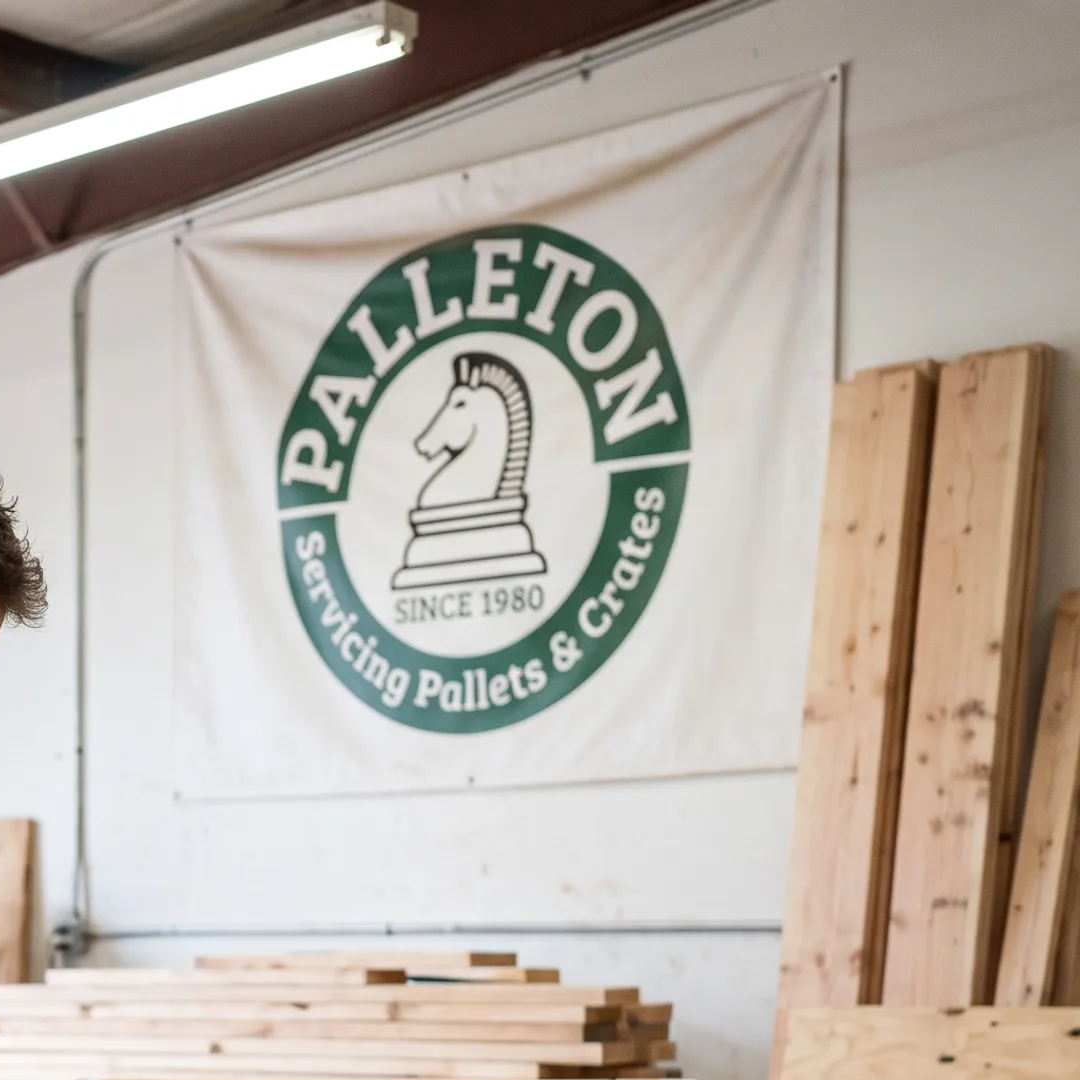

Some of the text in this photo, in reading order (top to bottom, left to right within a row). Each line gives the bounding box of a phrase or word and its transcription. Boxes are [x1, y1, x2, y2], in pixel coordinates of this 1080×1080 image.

[282, 238, 677, 493] PALLETON
[296, 486, 665, 712] Servicing Pallets & Crates
[394, 584, 545, 624] SINCE 1980
